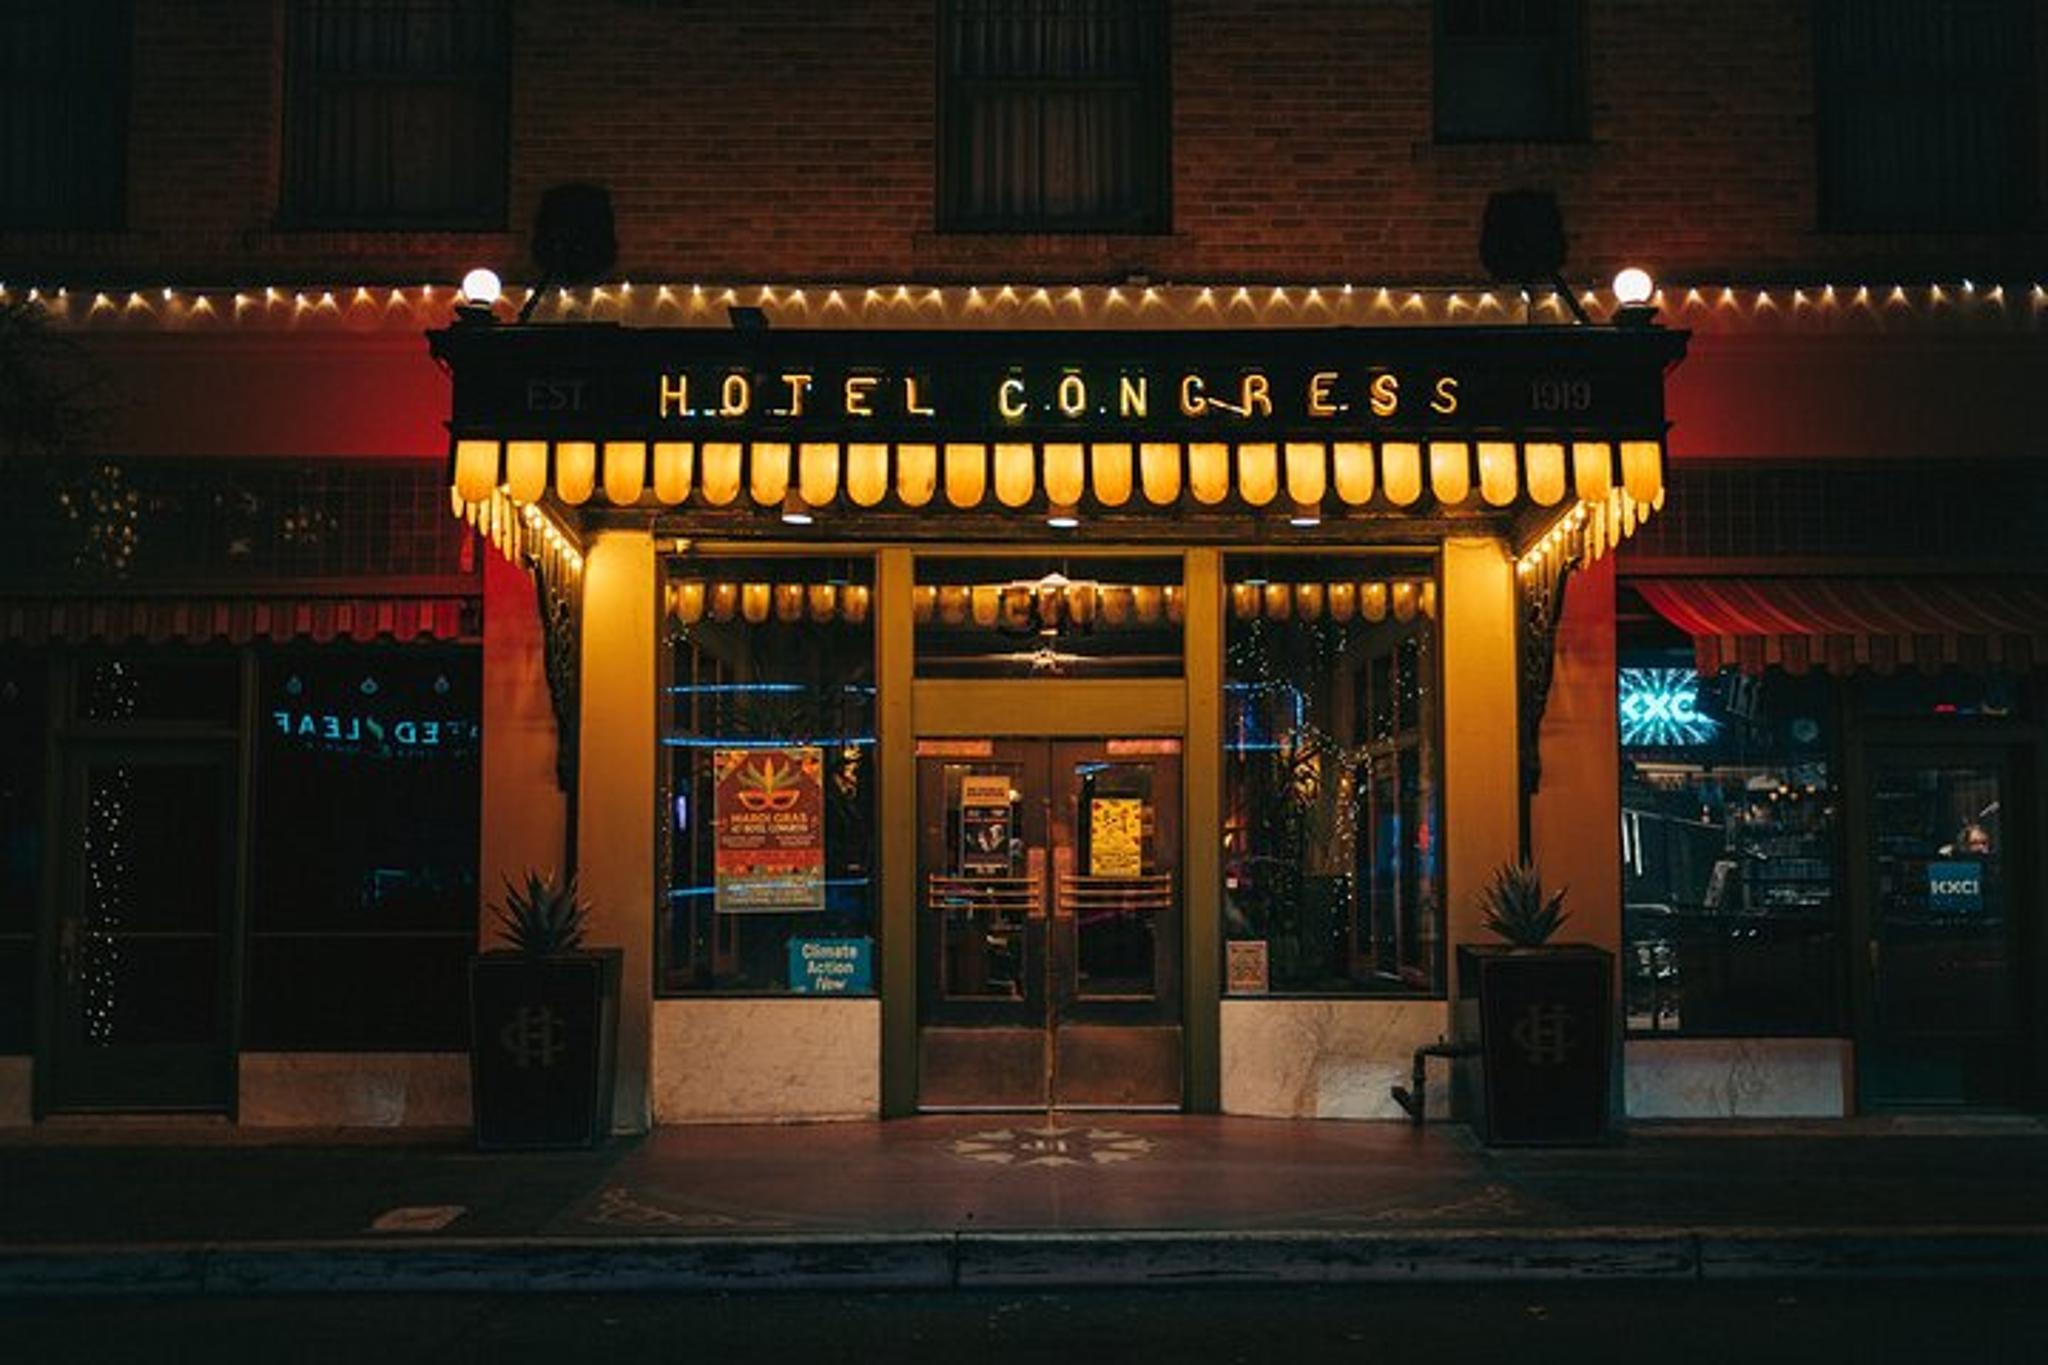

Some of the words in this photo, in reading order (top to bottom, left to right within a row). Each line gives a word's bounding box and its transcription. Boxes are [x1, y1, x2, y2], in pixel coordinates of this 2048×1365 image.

[657, 372, 936, 419] HOTEL
[997, 370, 1460, 420] CONGRESS
[1530, 378, 1592, 411] 1919
[1930, 879, 1980, 895] KXCI
[801, 942, 859, 960] Climate
[806, 960, 855, 976] Action
